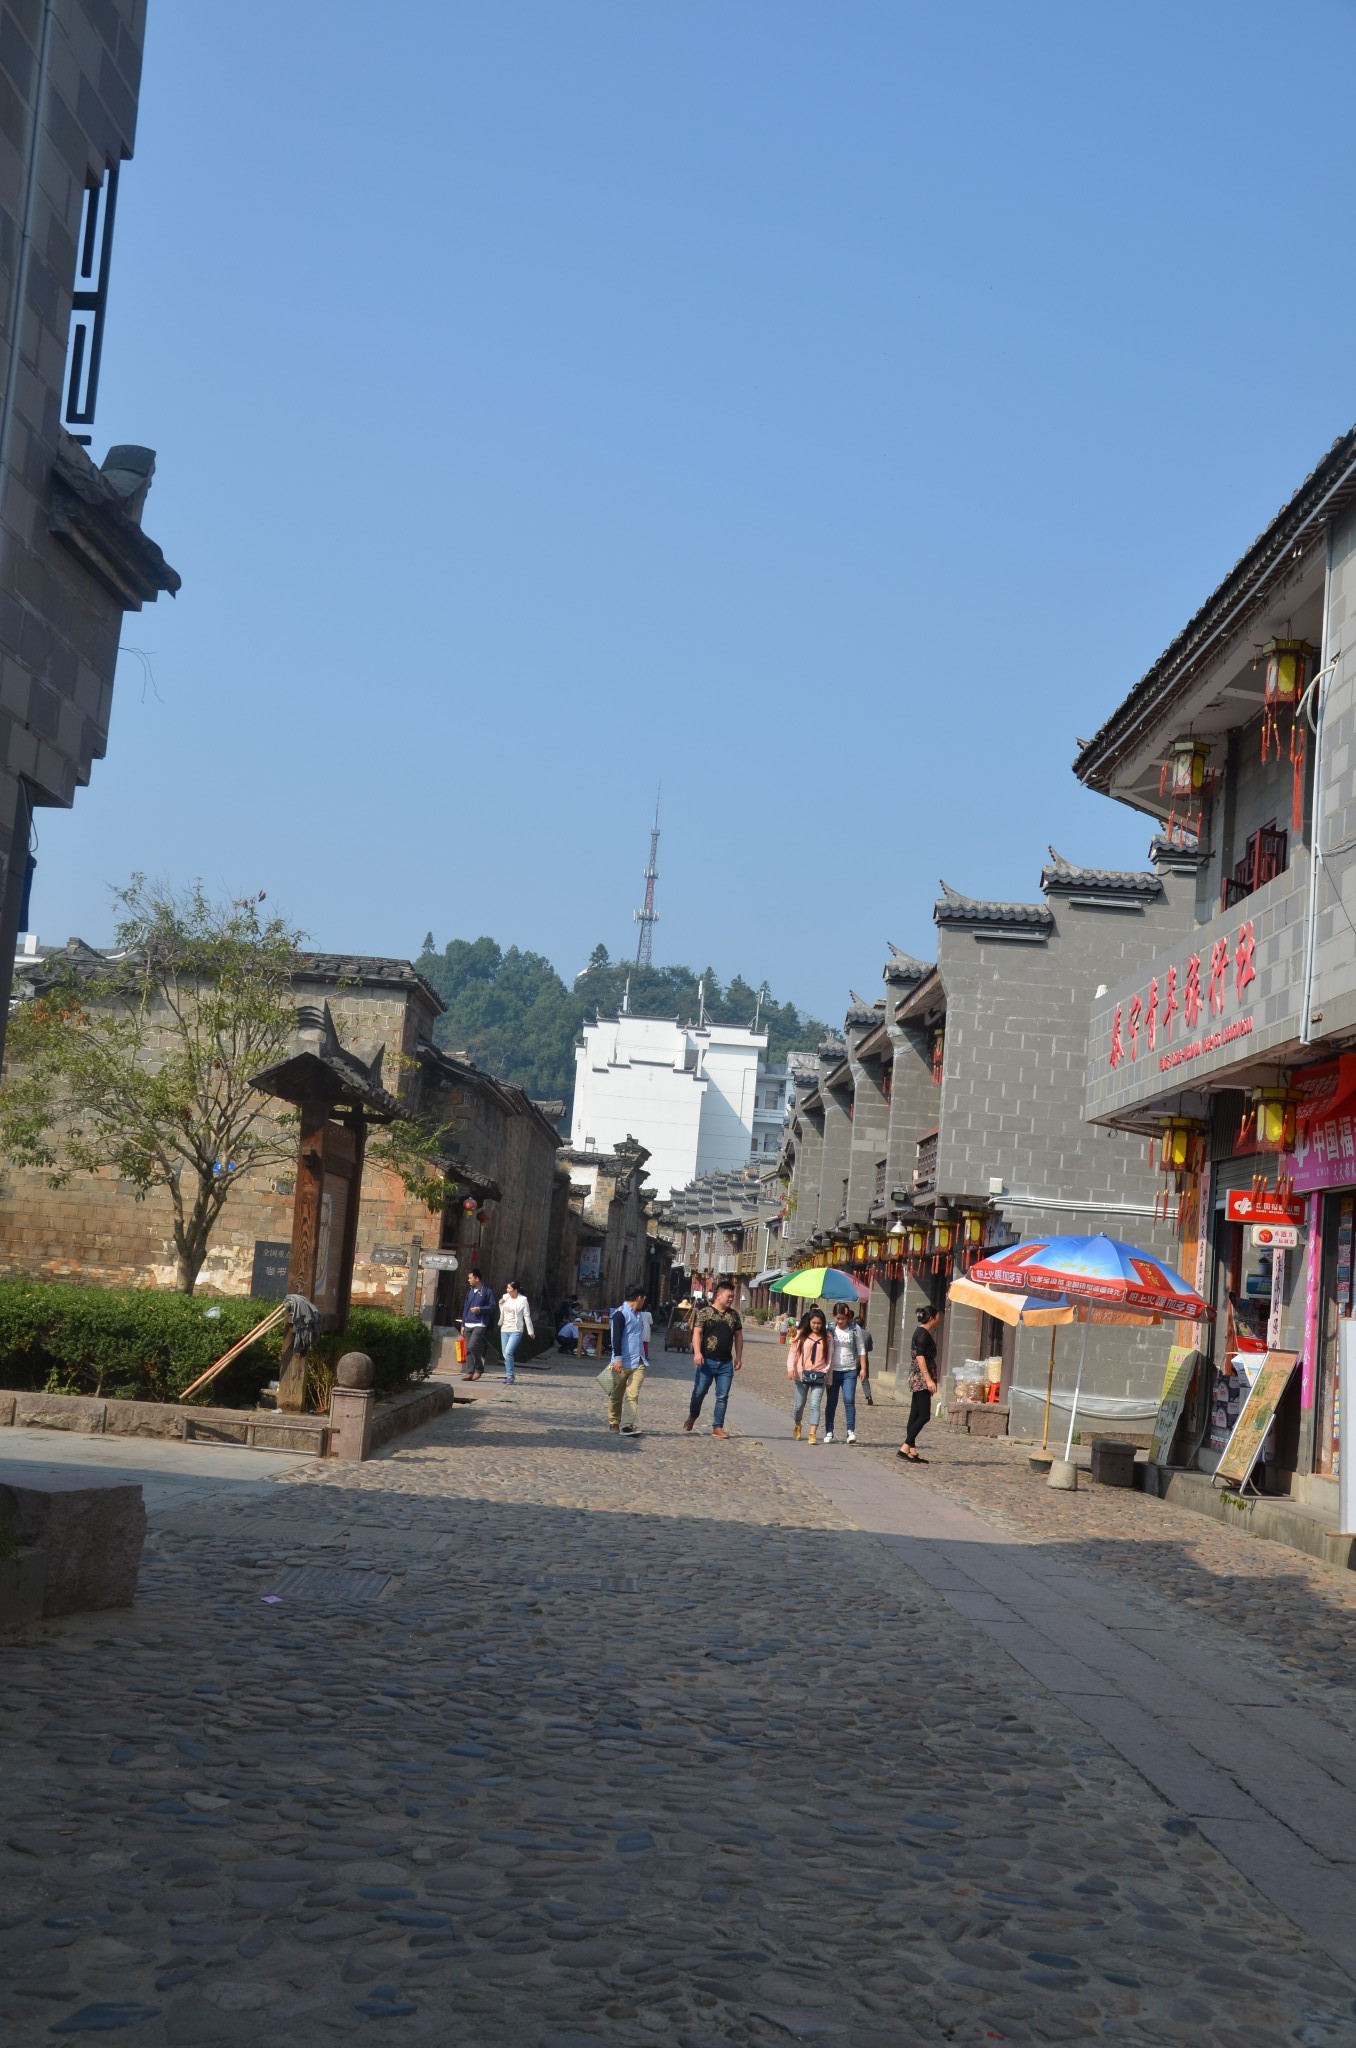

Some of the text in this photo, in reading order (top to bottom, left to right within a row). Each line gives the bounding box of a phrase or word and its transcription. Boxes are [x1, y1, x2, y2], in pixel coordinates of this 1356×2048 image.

[1109, 920, 1256, 1070] 泰宁青年旅行社
[1312, 1116, 1356, 1163] 中国福
